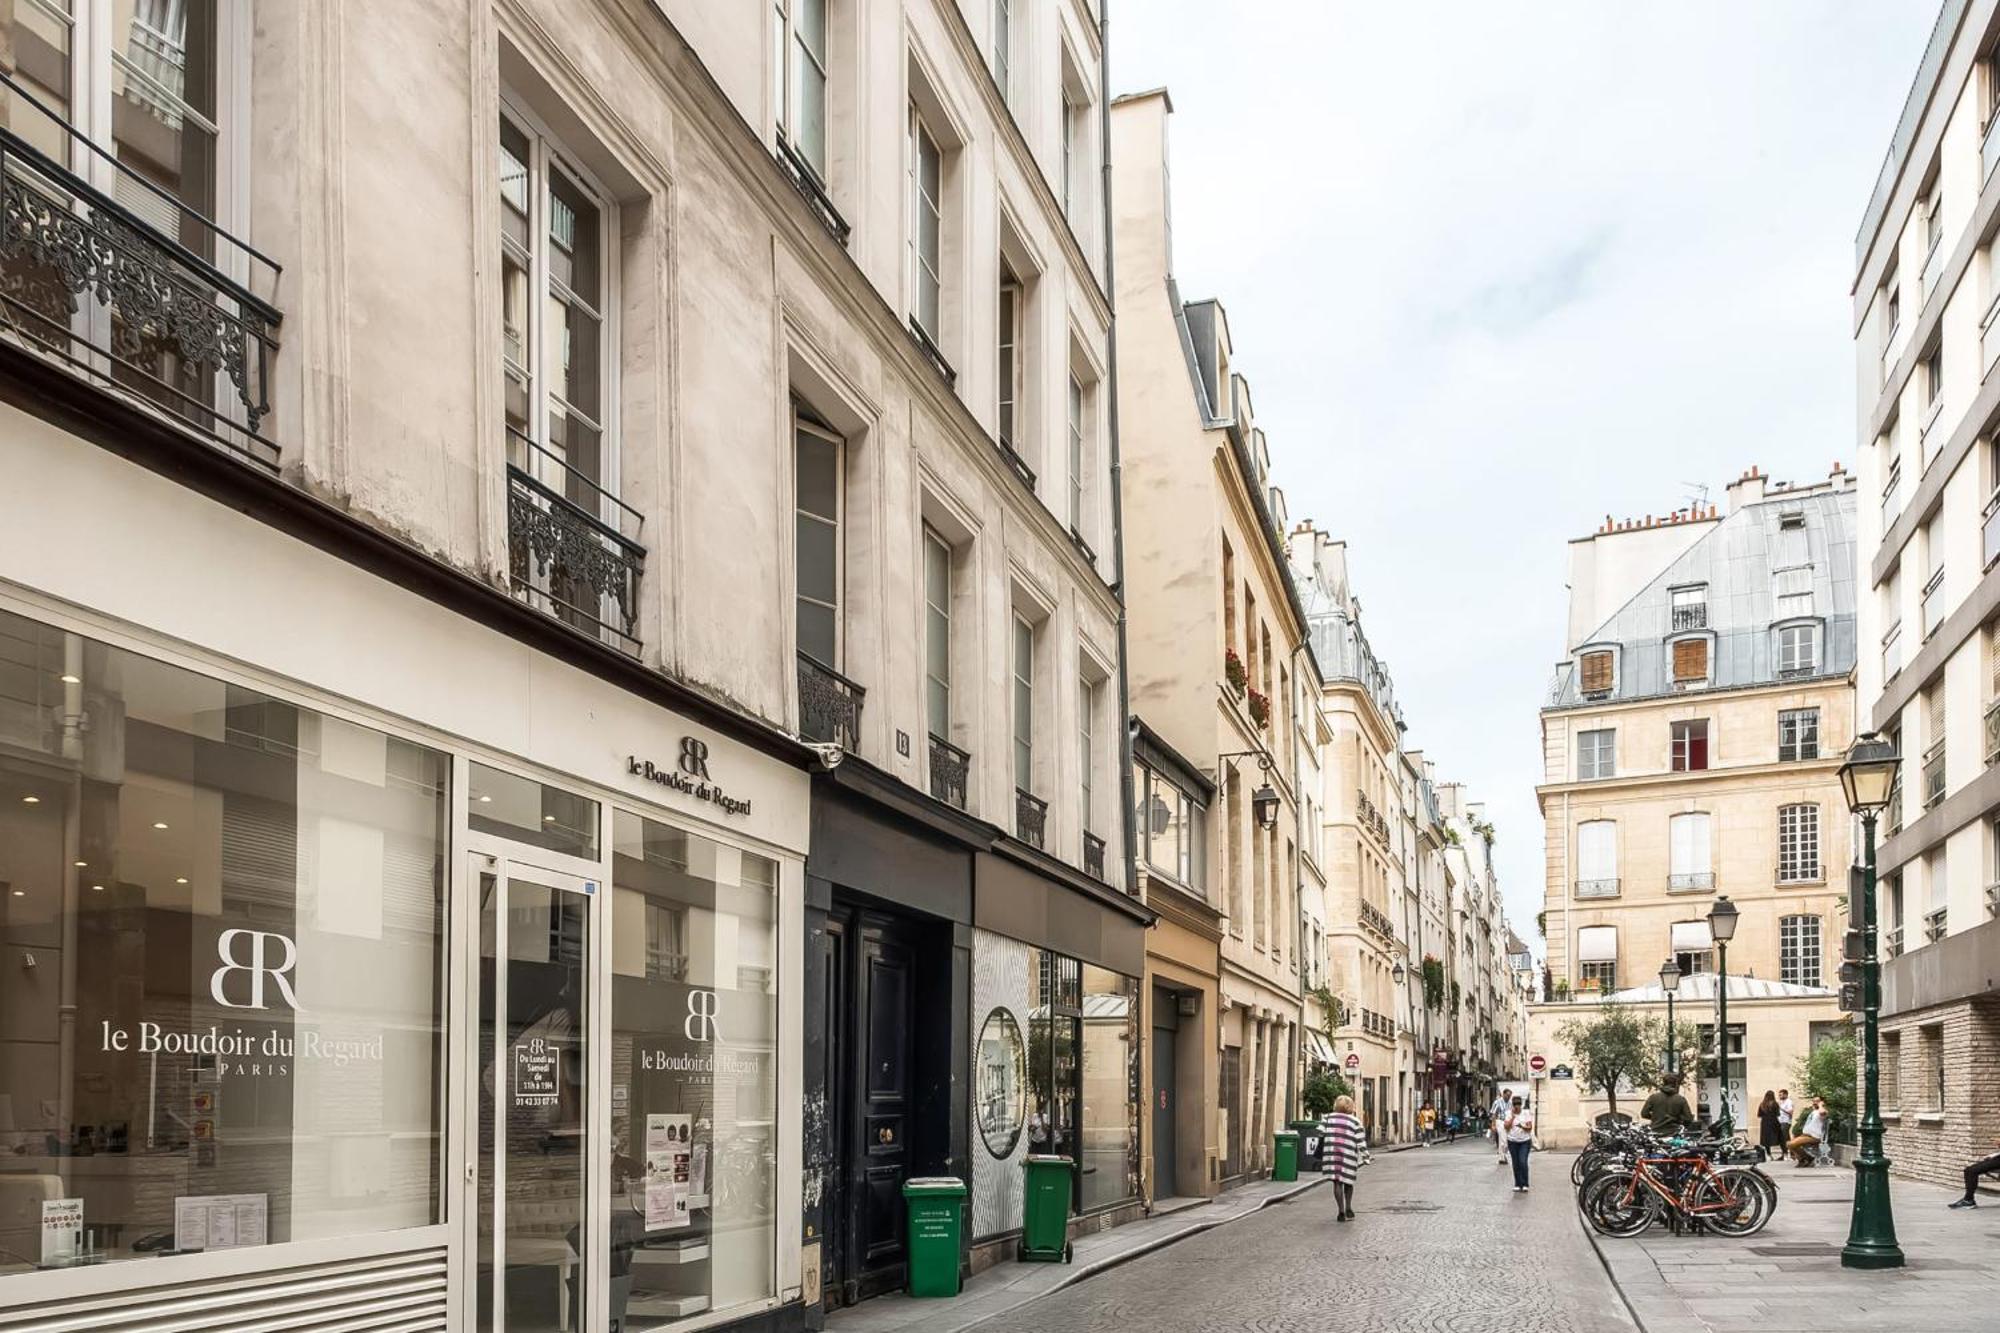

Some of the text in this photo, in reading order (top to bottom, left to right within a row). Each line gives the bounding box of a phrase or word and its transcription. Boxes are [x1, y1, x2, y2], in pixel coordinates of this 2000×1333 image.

[627, 756, 752, 816] le Boudoir du Regard
[101, 1021, 384, 1067] le Boudoir du Regard
[519, 1054, 529, 1063] Du
[529, 1055, 547, 1063] Lundi
[641, 1050, 653, 1070] le
[656, 1050, 704, 1072] Boudoir
[220, 1063, 288, 1076] PARIS
[527, 1063, 550, 1072] Samedi
[534, 1073, 542, 1081] de
